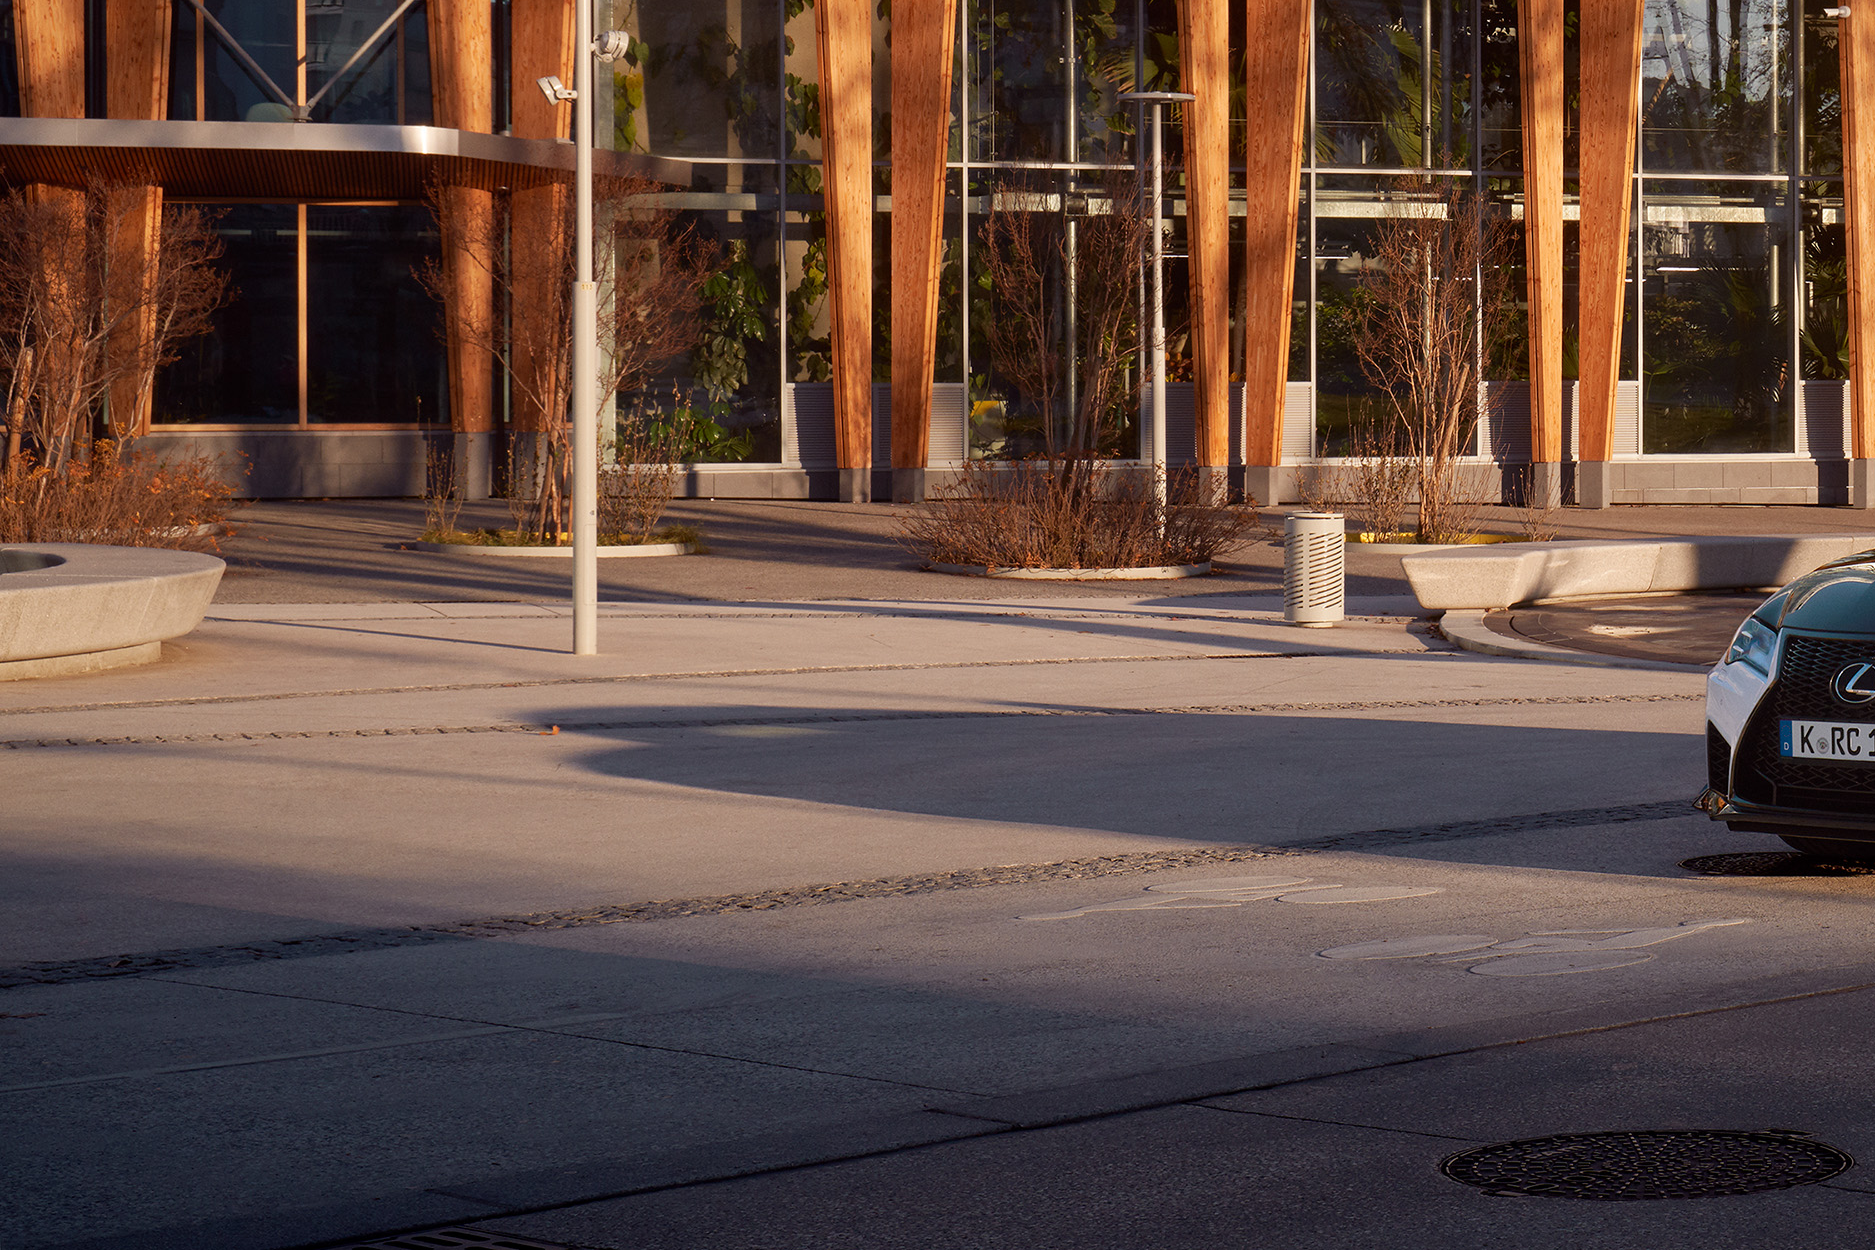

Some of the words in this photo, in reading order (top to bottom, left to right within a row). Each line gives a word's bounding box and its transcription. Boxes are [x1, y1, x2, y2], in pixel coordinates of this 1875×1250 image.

[1783, 741, 1790, 751] D
[1800, 725, 1815, 754] K
[1831, 726, 1862, 756] RC
